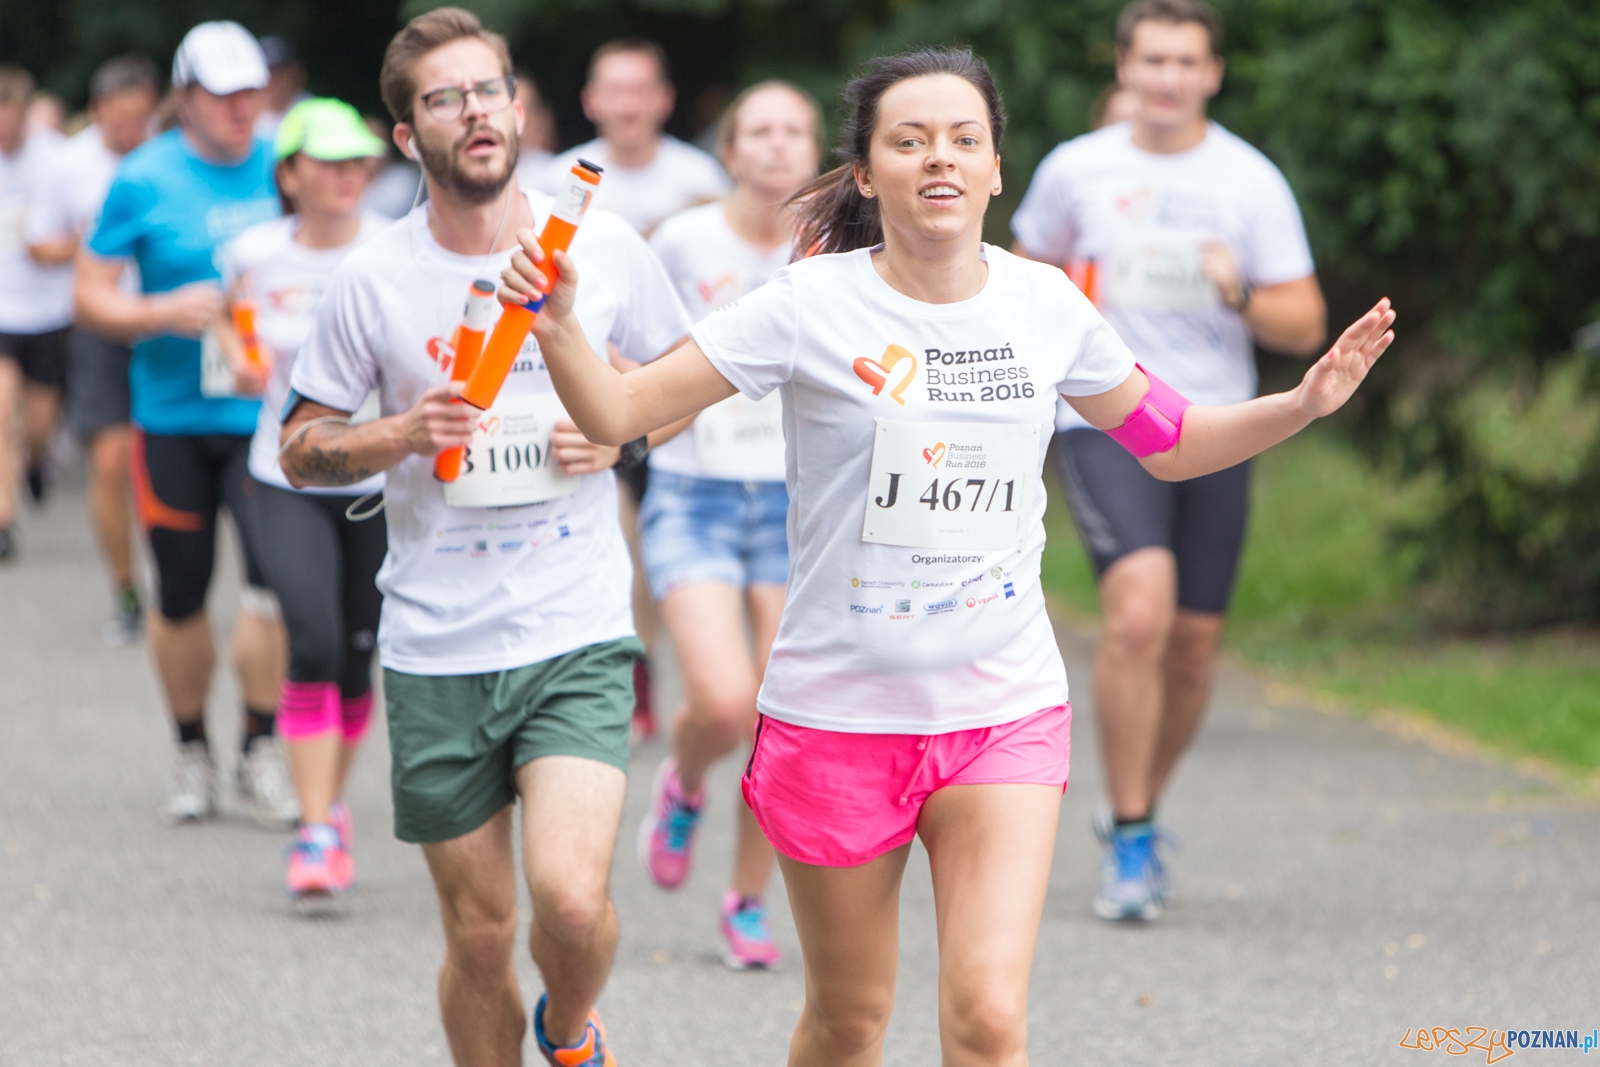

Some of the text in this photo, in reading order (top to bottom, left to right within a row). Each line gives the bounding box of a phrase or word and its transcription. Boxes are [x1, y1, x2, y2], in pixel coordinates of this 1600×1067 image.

[924, 342, 1015, 366] Poznań
[925, 366, 1030, 386] Business
[926, 382, 1035, 402] Run 2016
[488, 441, 552, 473] 100/
[946, 452, 987, 460] Business
[948, 443, 983, 452] Poznań
[945, 460, 986, 469] Run 2016
[874, 472, 905, 509] J
[919, 477, 1015, 512] 467/1
[911, 554, 985, 566] Organizatorzy:
